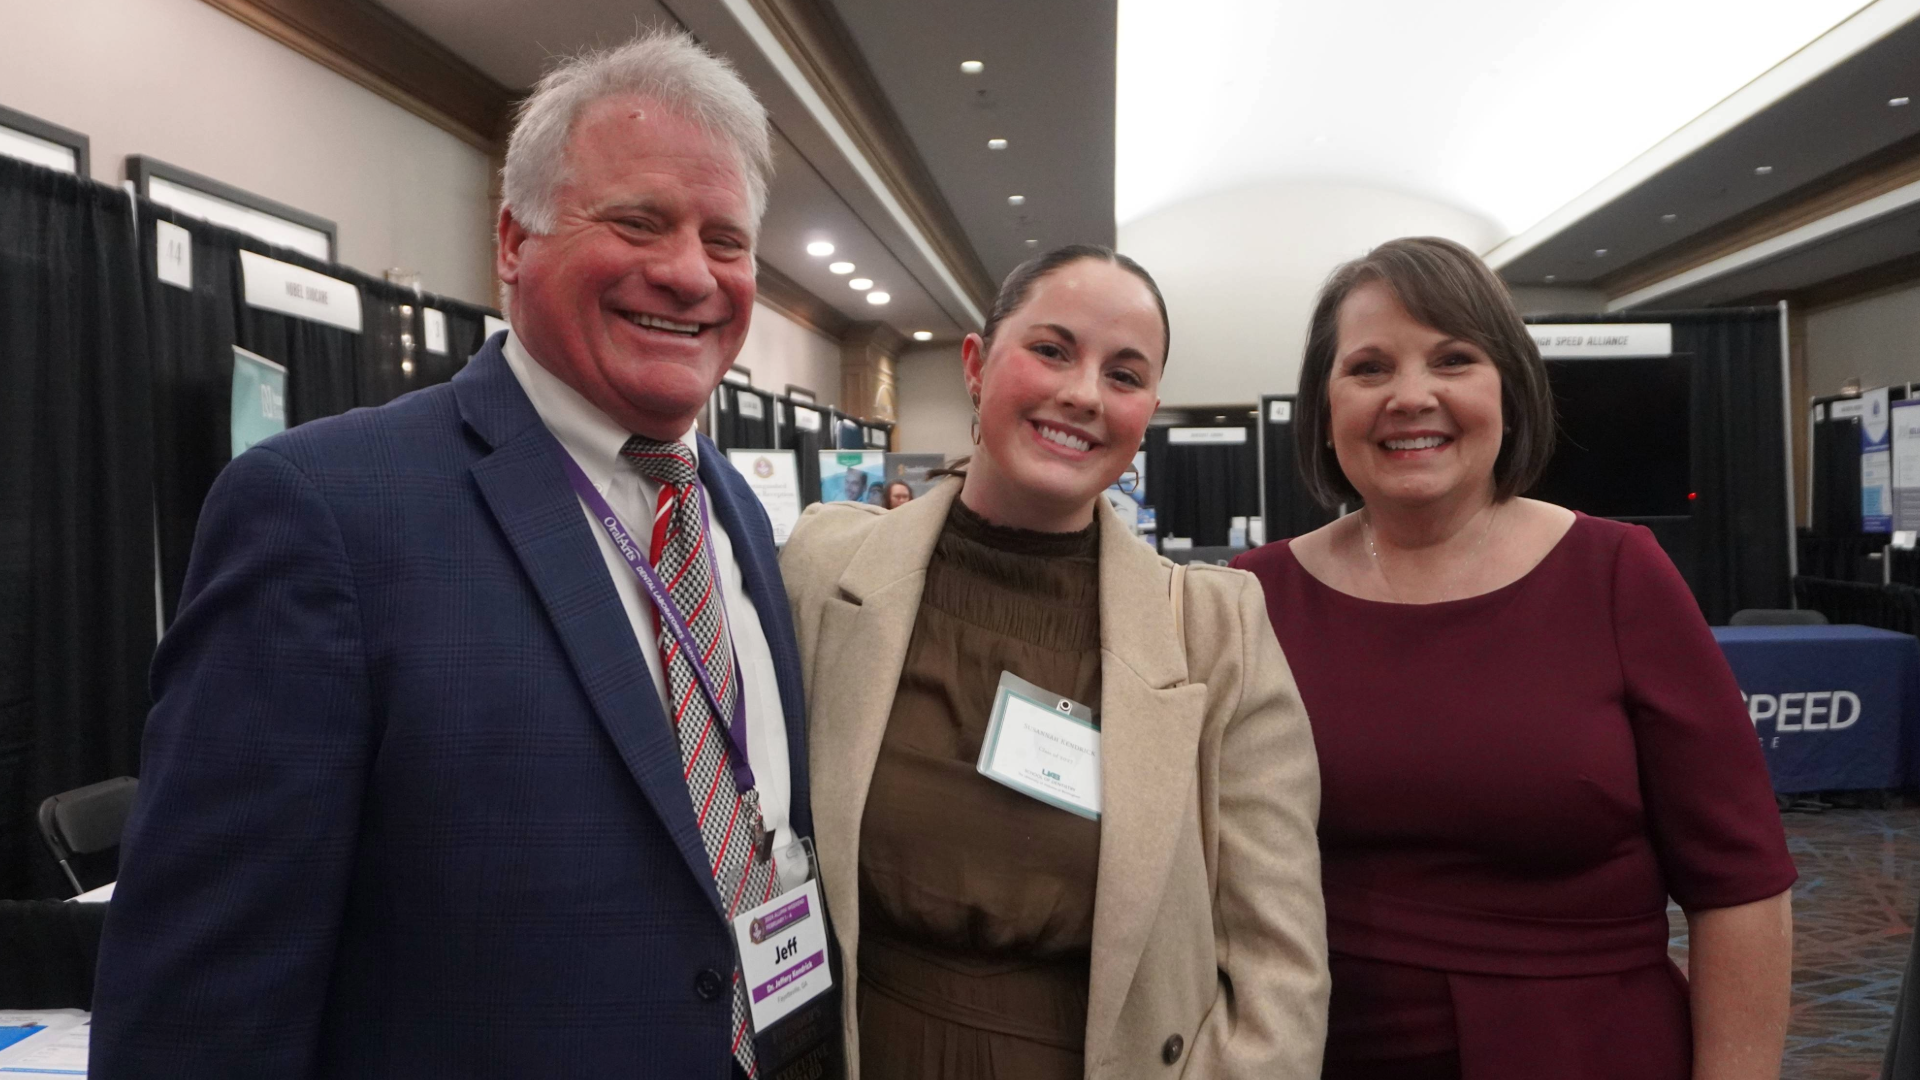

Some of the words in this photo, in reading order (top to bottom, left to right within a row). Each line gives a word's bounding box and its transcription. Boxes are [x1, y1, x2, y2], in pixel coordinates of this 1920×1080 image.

[1555, 335, 1583, 347] SPEED
[1586, 335, 1630, 347] ALLIANCE
[604, 516, 641, 562] OralArts
[636, 565, 655, 592] DENTAL
[653, 590, 685, 640] LABORATORIES
[1740, 690, 1861, 732] PEED
[1060, 739, 1096, 757] KENDRICK
[775, 936, 797, 965] Jeff
[792, 960, 813, 978] Kendrick
